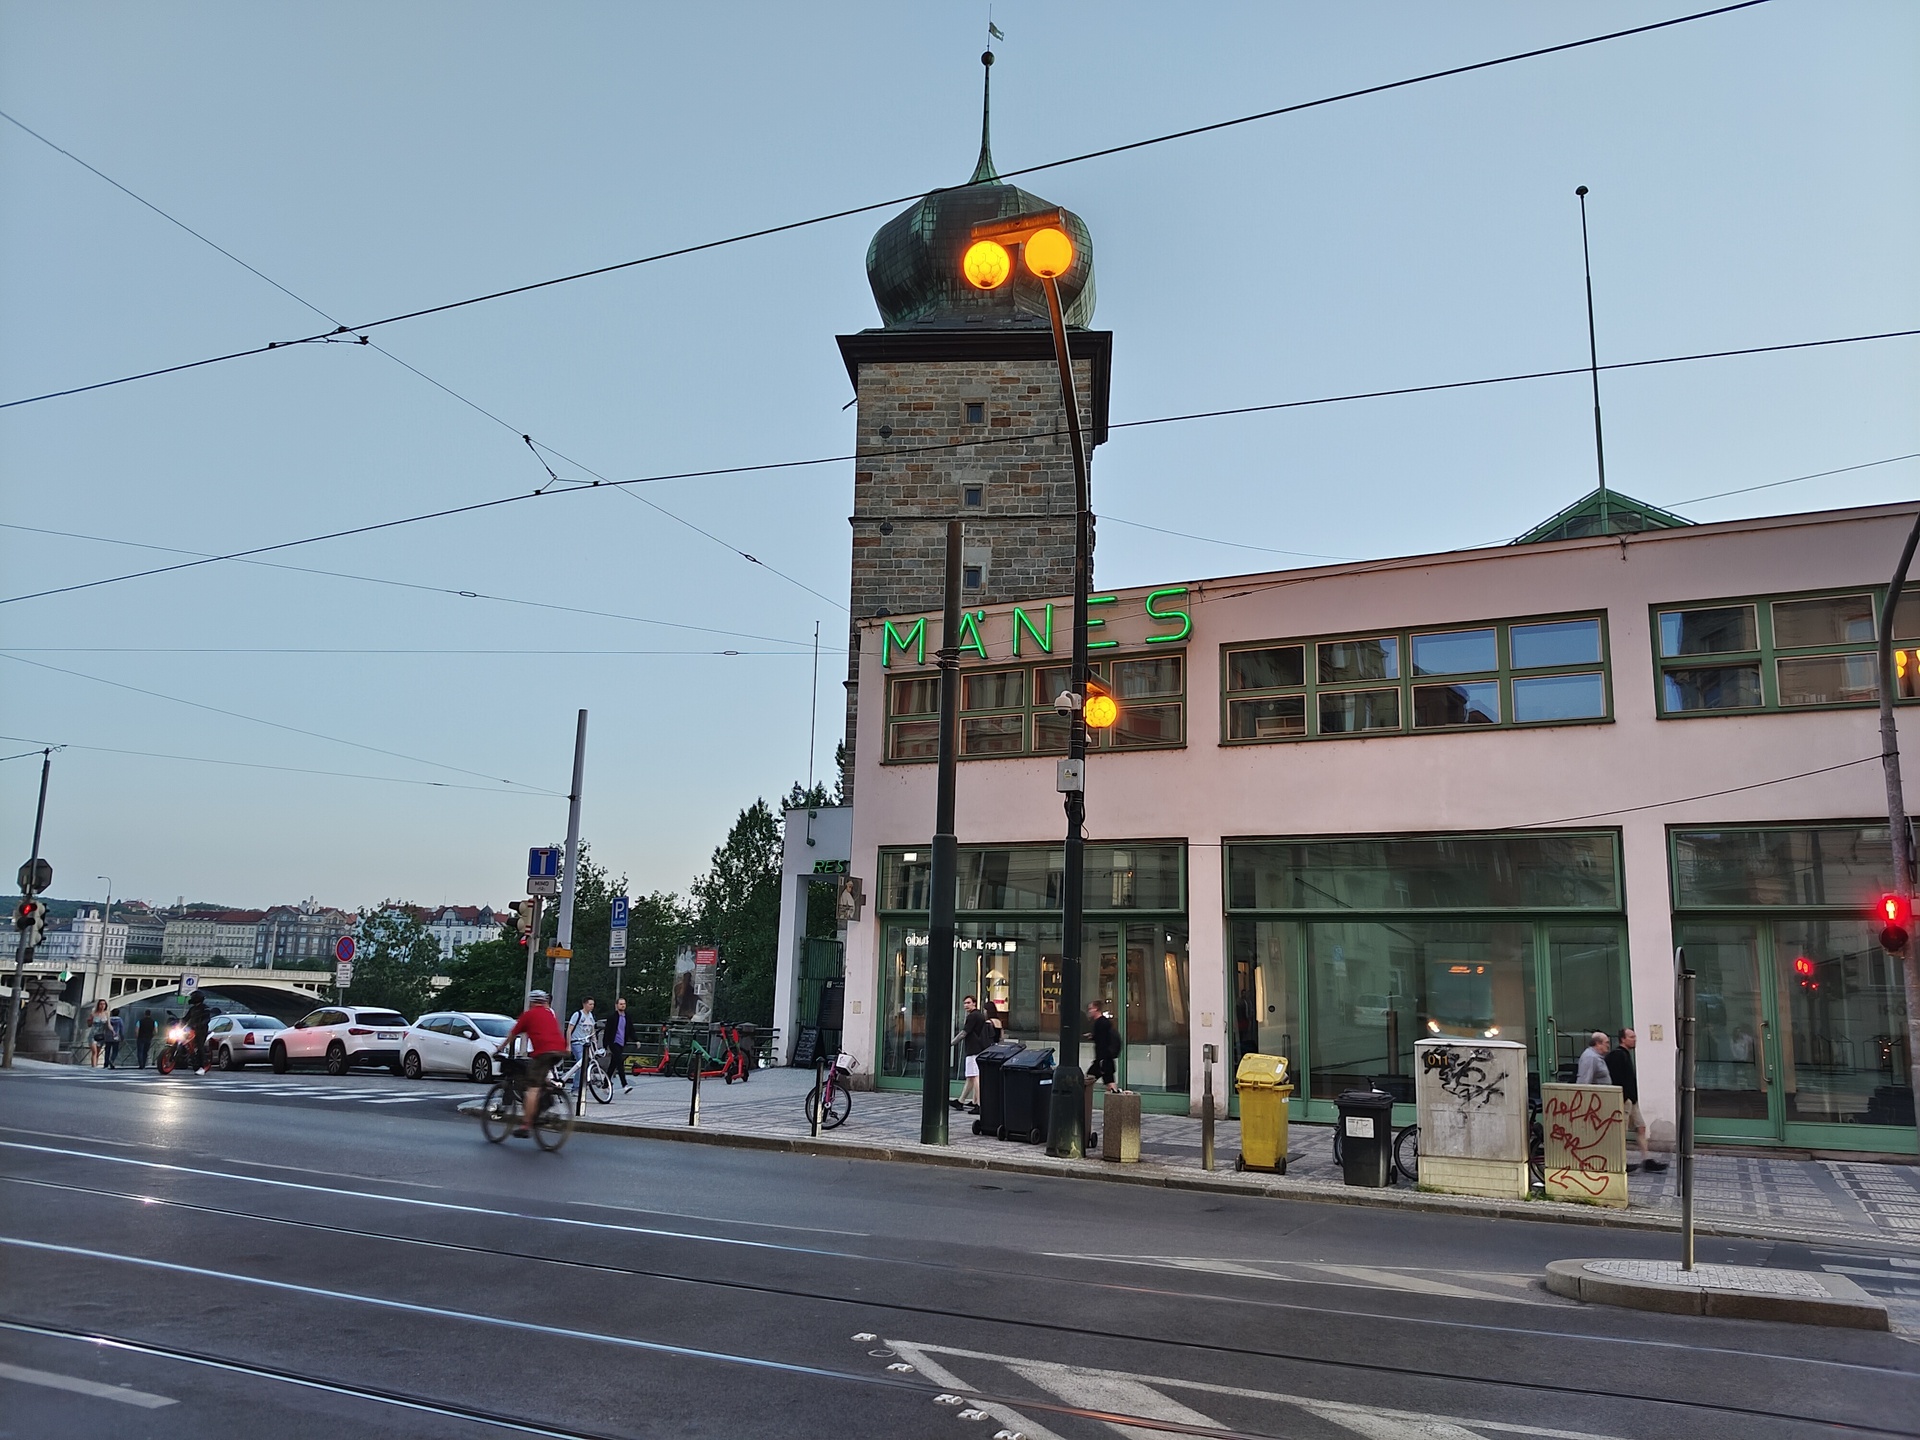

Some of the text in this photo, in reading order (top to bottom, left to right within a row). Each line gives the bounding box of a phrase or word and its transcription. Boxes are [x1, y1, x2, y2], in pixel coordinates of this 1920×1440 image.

[882, 587, 1192, 668] MÁNES
[812, 859, 848, 873] RES
[614, 901, 625, 919] P
